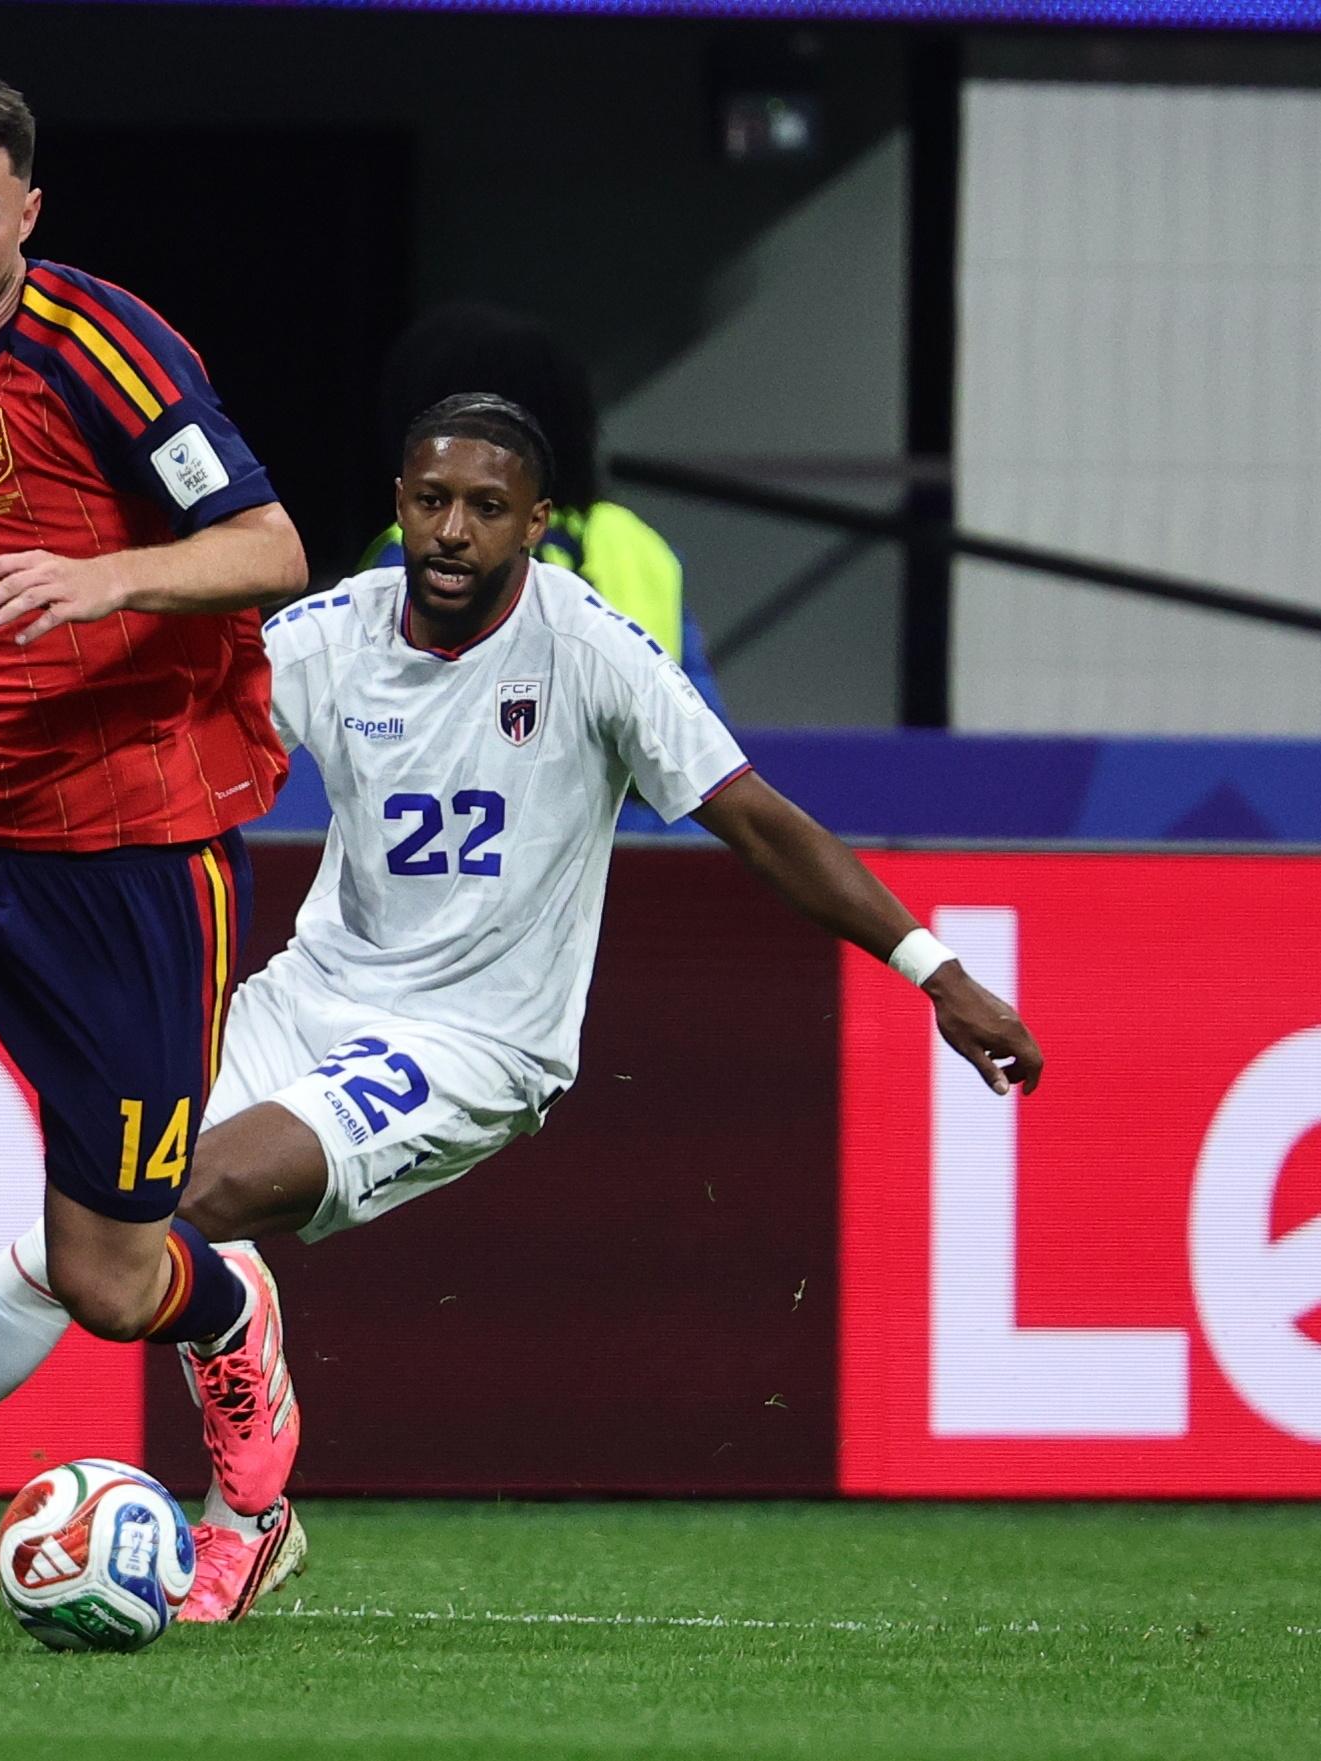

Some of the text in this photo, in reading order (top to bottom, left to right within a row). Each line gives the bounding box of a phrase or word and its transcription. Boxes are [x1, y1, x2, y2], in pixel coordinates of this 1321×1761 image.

[184, 468, 208, 490] PEACE
[500, 684, 537, 695] FCF
[344, 716, 404, 737] capelli
[370, 731, 403, 740] SPORT
[384, 790, 506, 877] 22
[307, 1036, 430, 1134] 22
[324, 1090, 369, 1145] capelli
[117, 1096, 191, 1192] 14
